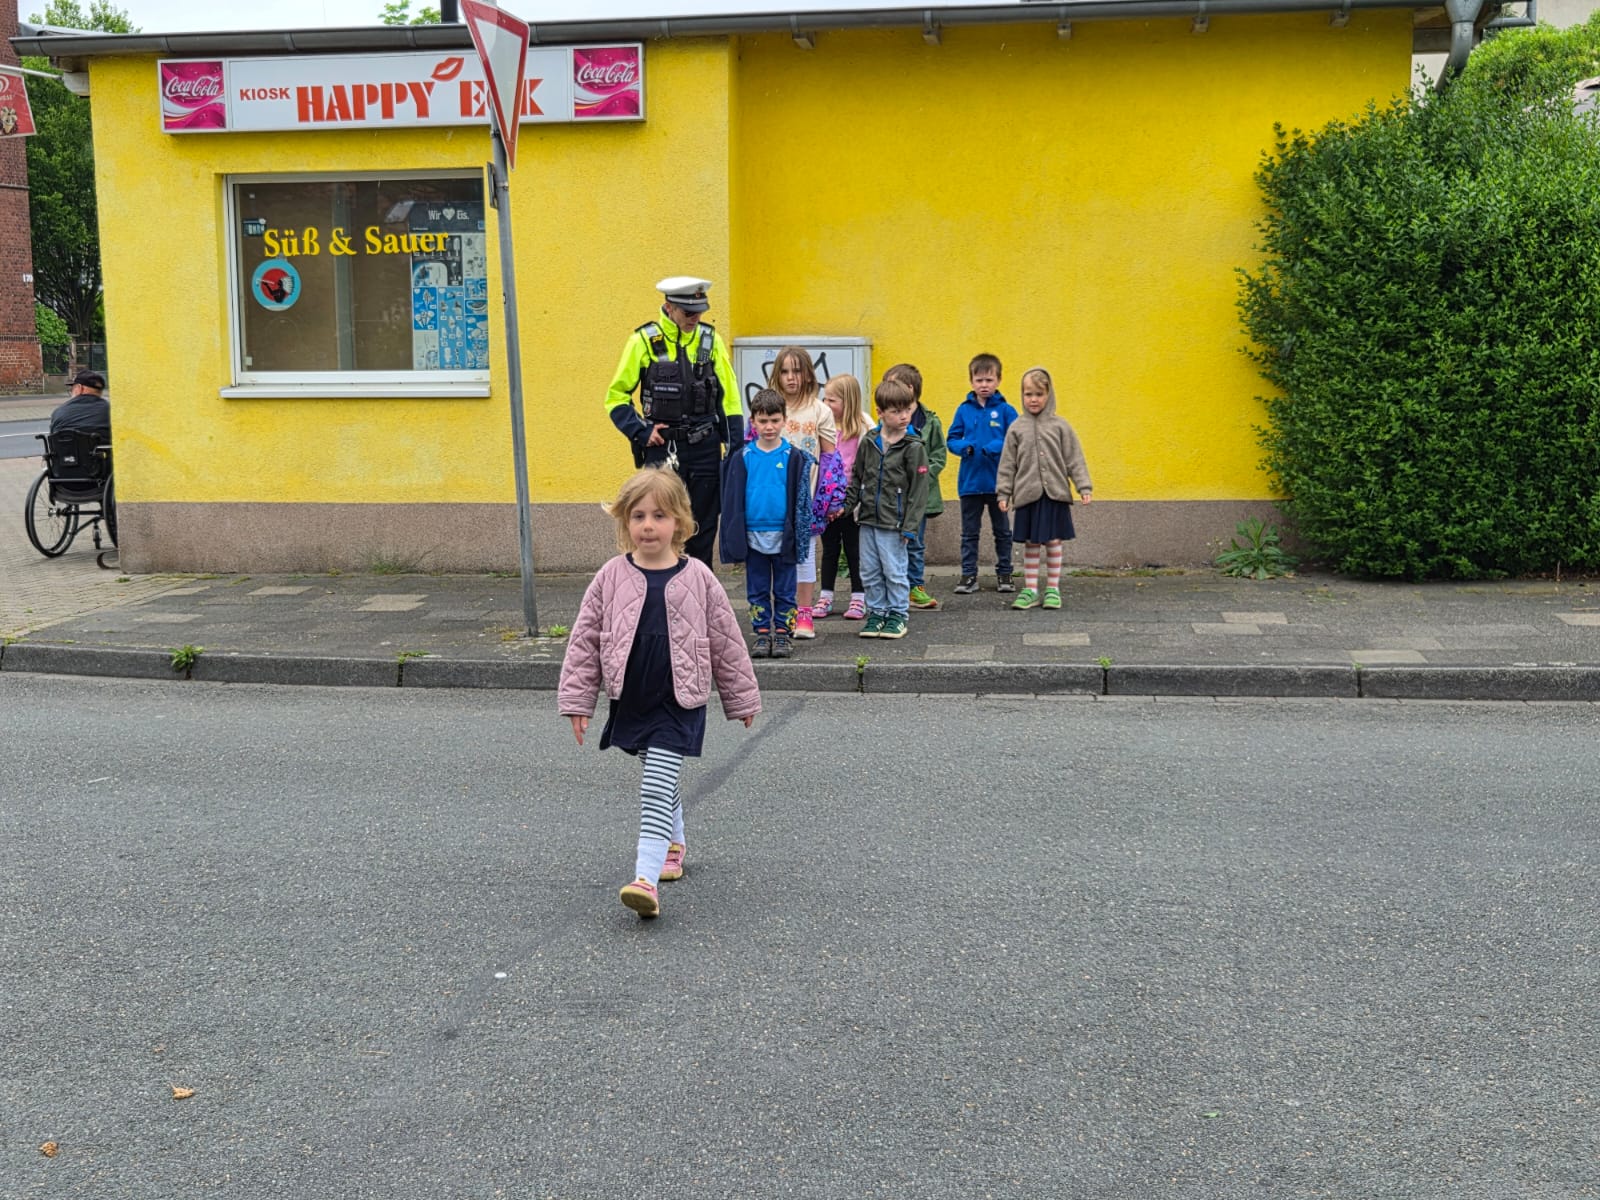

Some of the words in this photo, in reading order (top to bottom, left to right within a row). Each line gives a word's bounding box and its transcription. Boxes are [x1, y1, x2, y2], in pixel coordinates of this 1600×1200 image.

[577, 61, 637, 84] Coca-Cola
[165, 76, 220, 97] Coca-Cola
[239, 87, 291, 101] KIOSK
[296, 81, 435, 122] HAPPY
[459, 78, 544, 117] EK
[428, 209, 441, 220] Wir
[264, 227, 320, 257] Süß
[328, 227, 358, 256] &
[365, 225, 449, 255] Sauer
